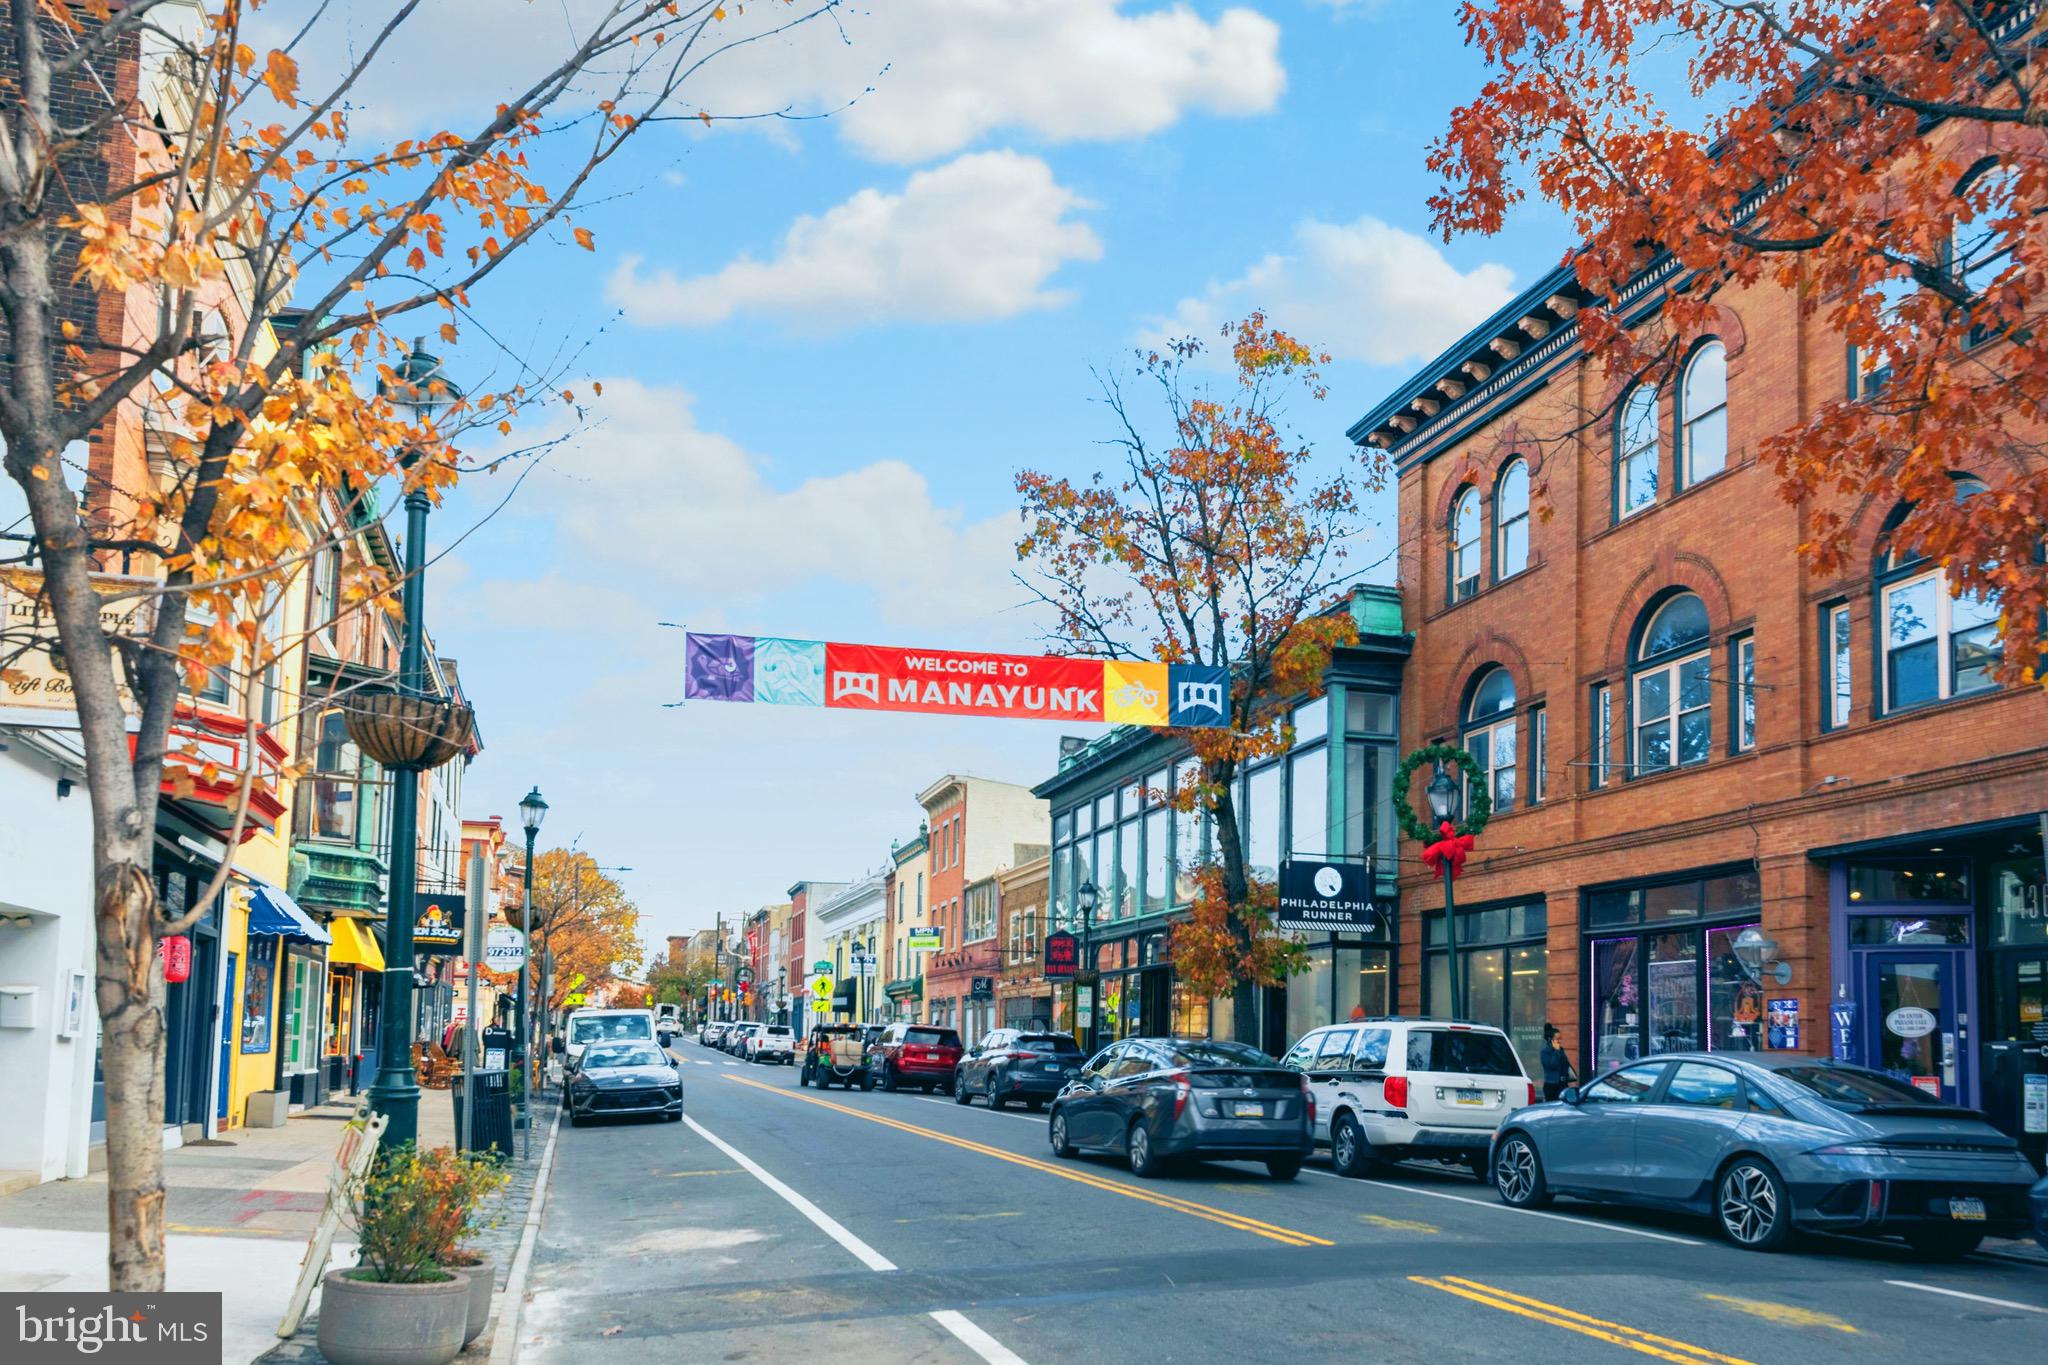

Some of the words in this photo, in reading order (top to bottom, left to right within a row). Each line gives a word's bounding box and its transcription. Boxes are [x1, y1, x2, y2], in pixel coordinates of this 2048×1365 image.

[905, 656, 997, 675] WELCOME
[1002, 662, 1028, 676] TO
[888, 678, 1099, 713] MANAYUNK
[1281, 898, 1374, 911] PHILADELPHIA
[1303, 911, 1352, 921] RUNNER
[914, 927, 934, 936] MPN
[488, 947, 522, 957] 972912
